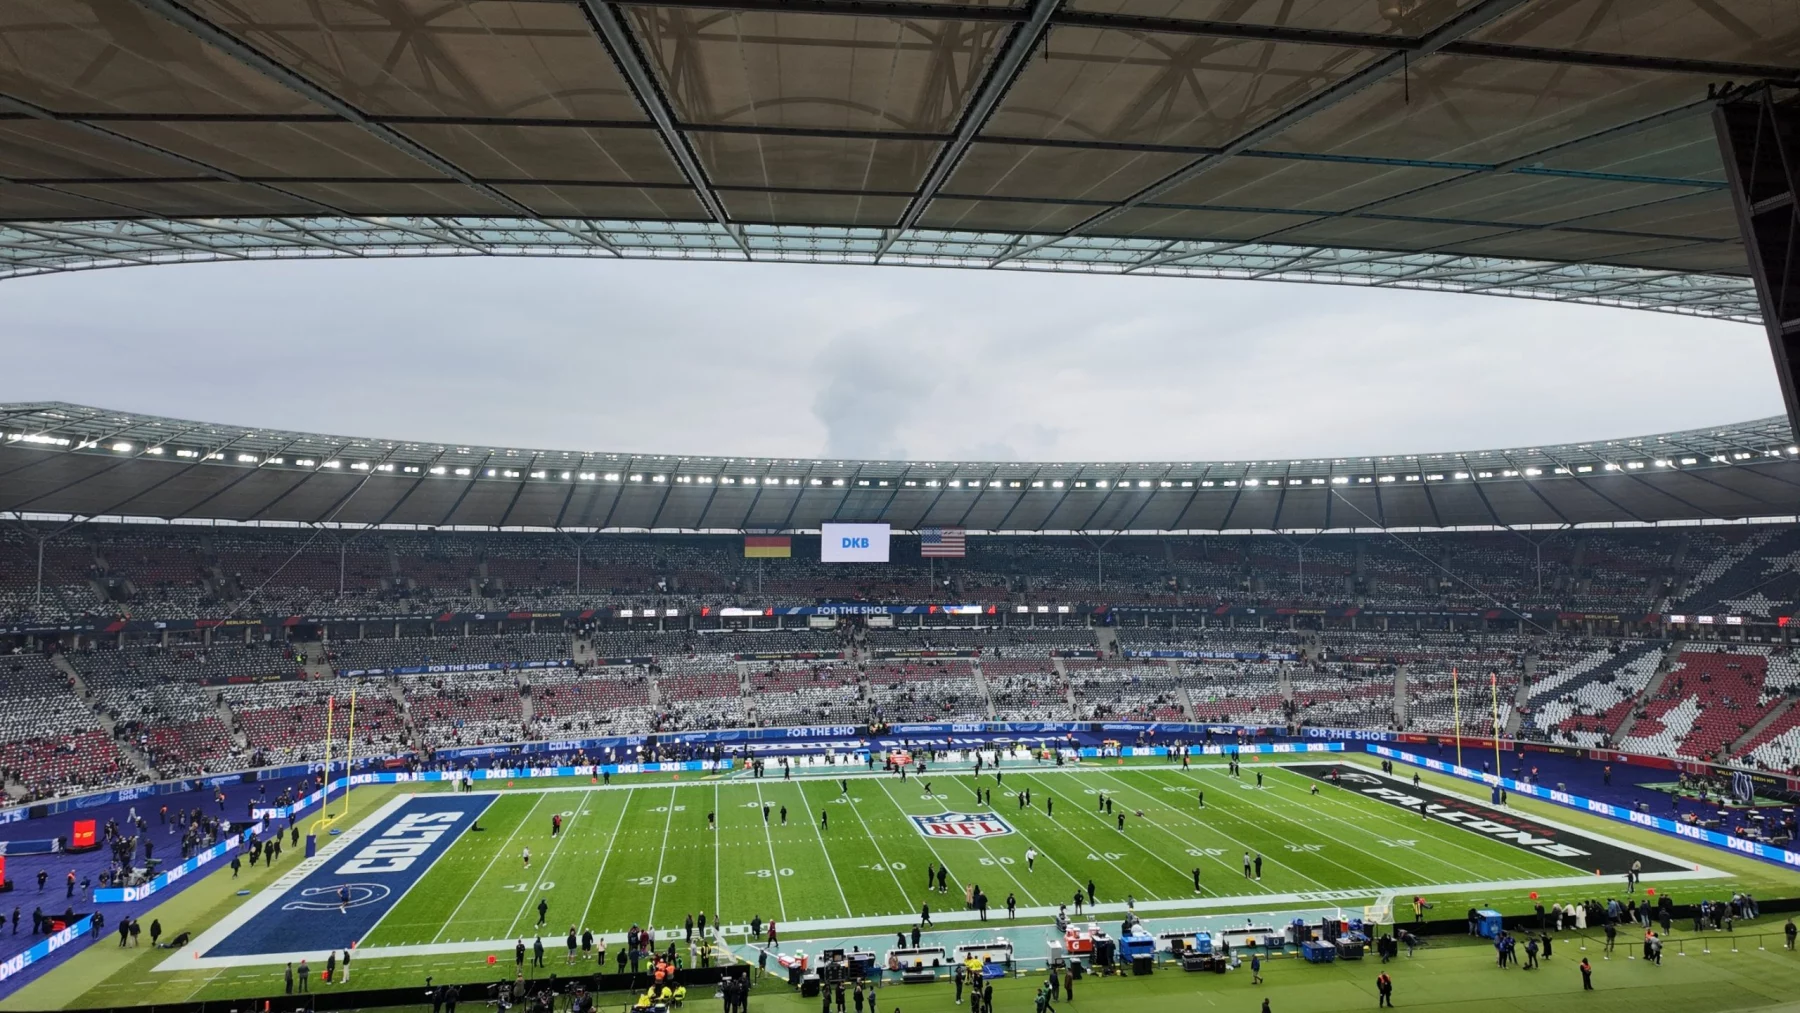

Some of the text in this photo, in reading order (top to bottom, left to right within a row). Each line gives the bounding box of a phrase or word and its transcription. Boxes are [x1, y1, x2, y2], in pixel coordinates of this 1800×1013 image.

[842, 537, 869, 548] DKB
[817, 606, 888, 615] FOR THE SHOE
[428, 663, 490, 673] FOR THE SHOE
[787, 728, 807, 737] FOR
[811, 727, 830, 736] THE
[952, 724, 980, 732] COLTS
[1330, 730, 1352, 739] THE
[1355, 731, 1387, 740] SHOE
[549, 741, 580, 750] COLTS
[1132, 746, 1150, 755] DKB
[1203, 745, 1220, 754] DKB
[1239, 744, 1255, 753] DKB
[1273, 744, 1290, 753] DKB
[1307, 743, 1323, 752] DKB
[308, 761, 335, 775] FOR
[617, 764, 638, 774] DKB
[660, 762, 680, 772] DKB
[350, 773, 372, 785] DKB
[441, 771, 462, 781] DKB
[486, 769, 507, 780] DKB
[1515, 780, 1532, 795] DKB
[1550, 789, 1569, 805] DKB
[1588, 800, 1609, 815] DKB
[252, 808, 277, 819] DKB
[1629, 811, 1651, 826] DKB
[1361, 787, 1592, 857] FALCONS
[930, 821, 1002, 836] NFL
[1675, 823, 1700, 839] DKB
[334, 811, 465, 875] COLTS
[1284, 843, 1322, 853] 20
[1727, 835, 1755, 854] DKB
[1087, 851, 1122, 861] 40
[1186, 847, 1222, 857] 30
[197, 850, 212, 868] DKB
[979, 856, 1015, 867] 50
[868, 861, 906, 872] 40
[167, 865, 183, 883] DKB
[754, 867, 794, 878] 30
[638, 874, 677, 885] 20
[512, 881, 555, 892] 10
[1297, 889, 1382, 901] BERLIN
[48, 926, 71, 953] DKB
[0, 953, 24, 980] DKB
